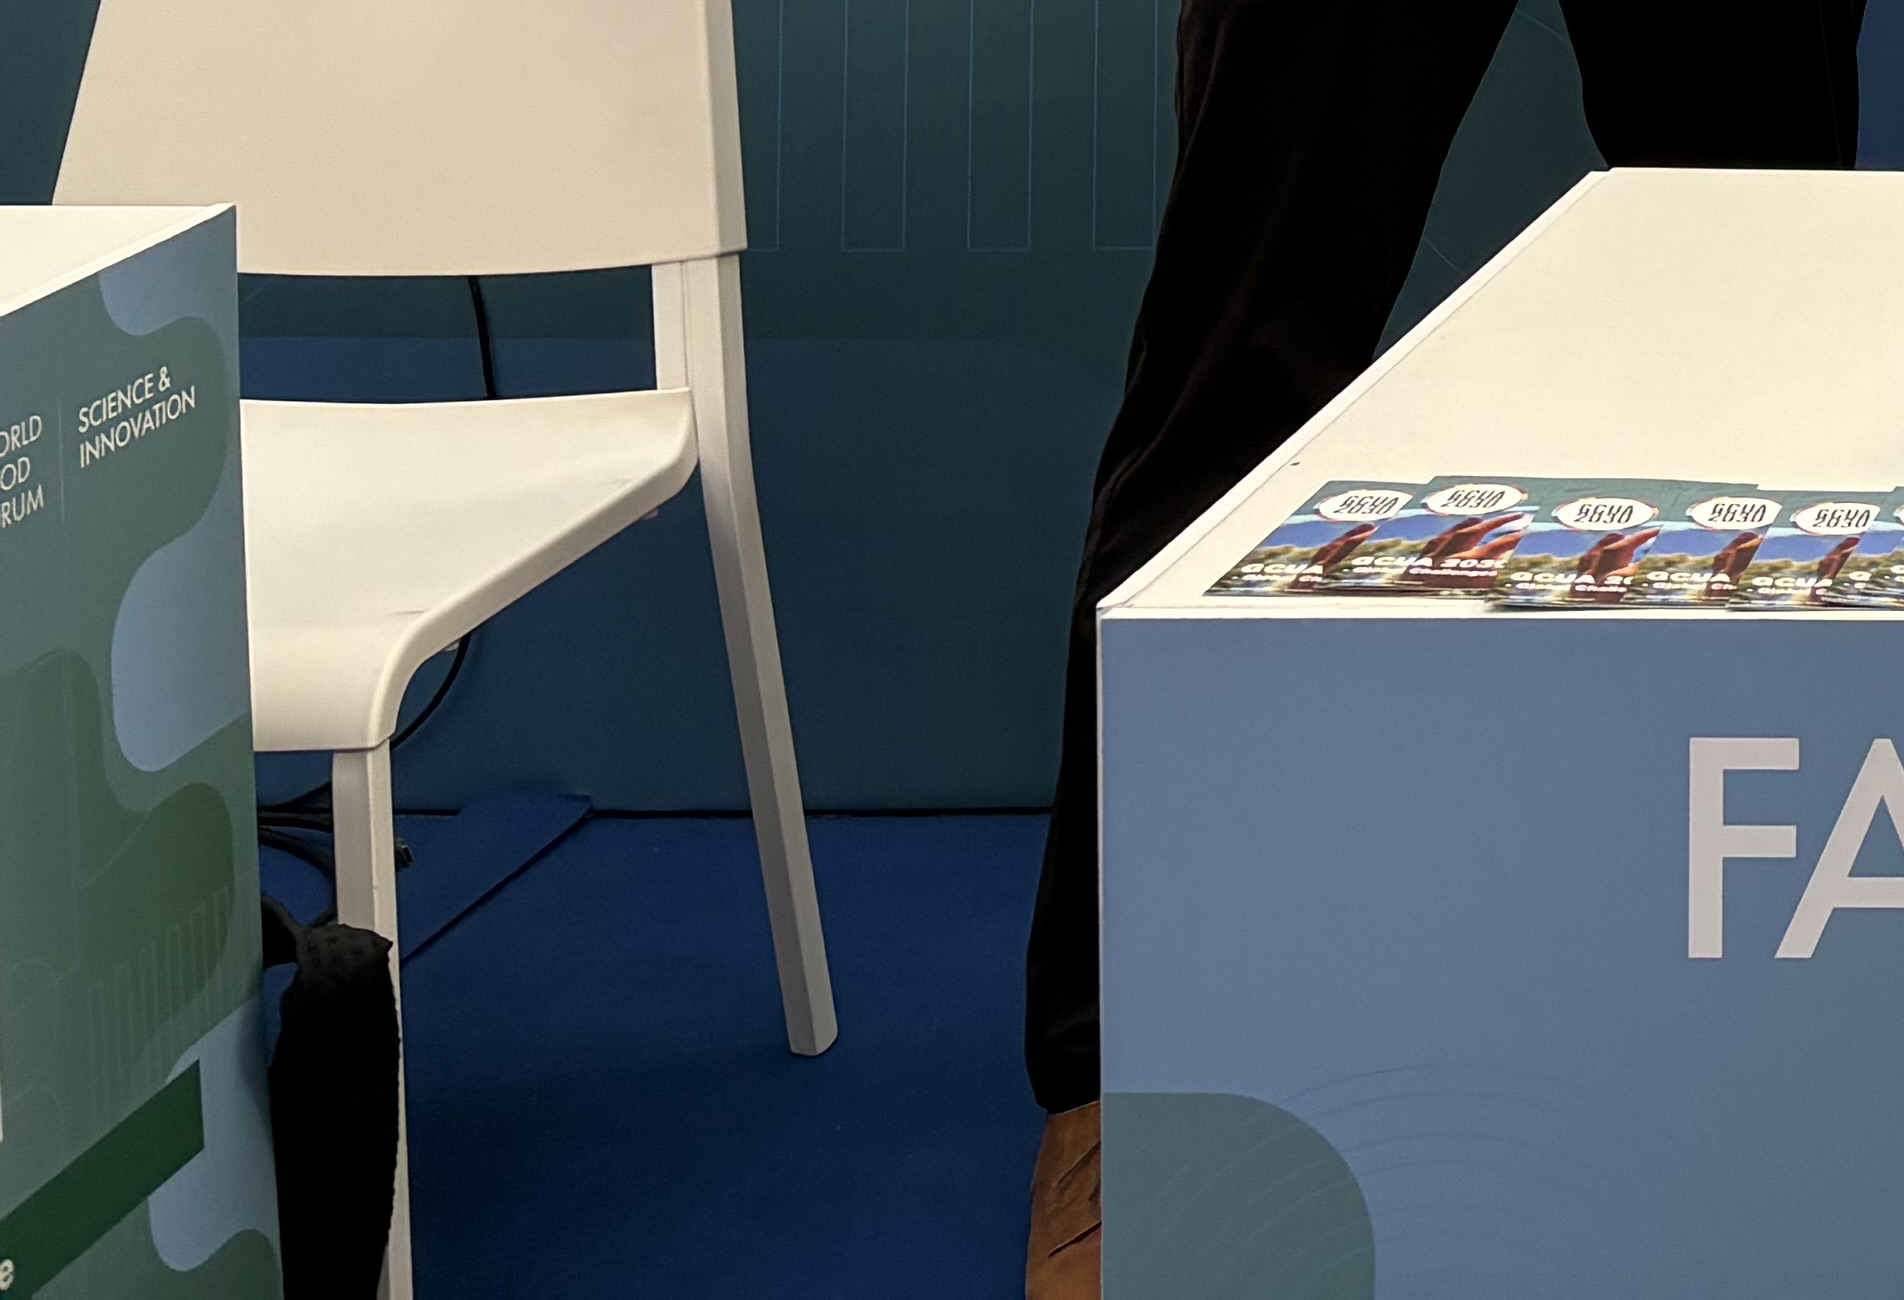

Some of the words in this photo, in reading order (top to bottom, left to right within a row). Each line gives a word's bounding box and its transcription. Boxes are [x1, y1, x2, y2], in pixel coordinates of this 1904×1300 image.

[78, 373, 154, 434] SCIENCE
[157, 365, 172, 393] &
[0, 414, 43, 458] ORLD
[79, 384, 197, 469] INNOVATION
[0, 456, 32, 492] OD
[1, 483, 45, 529] RUM
